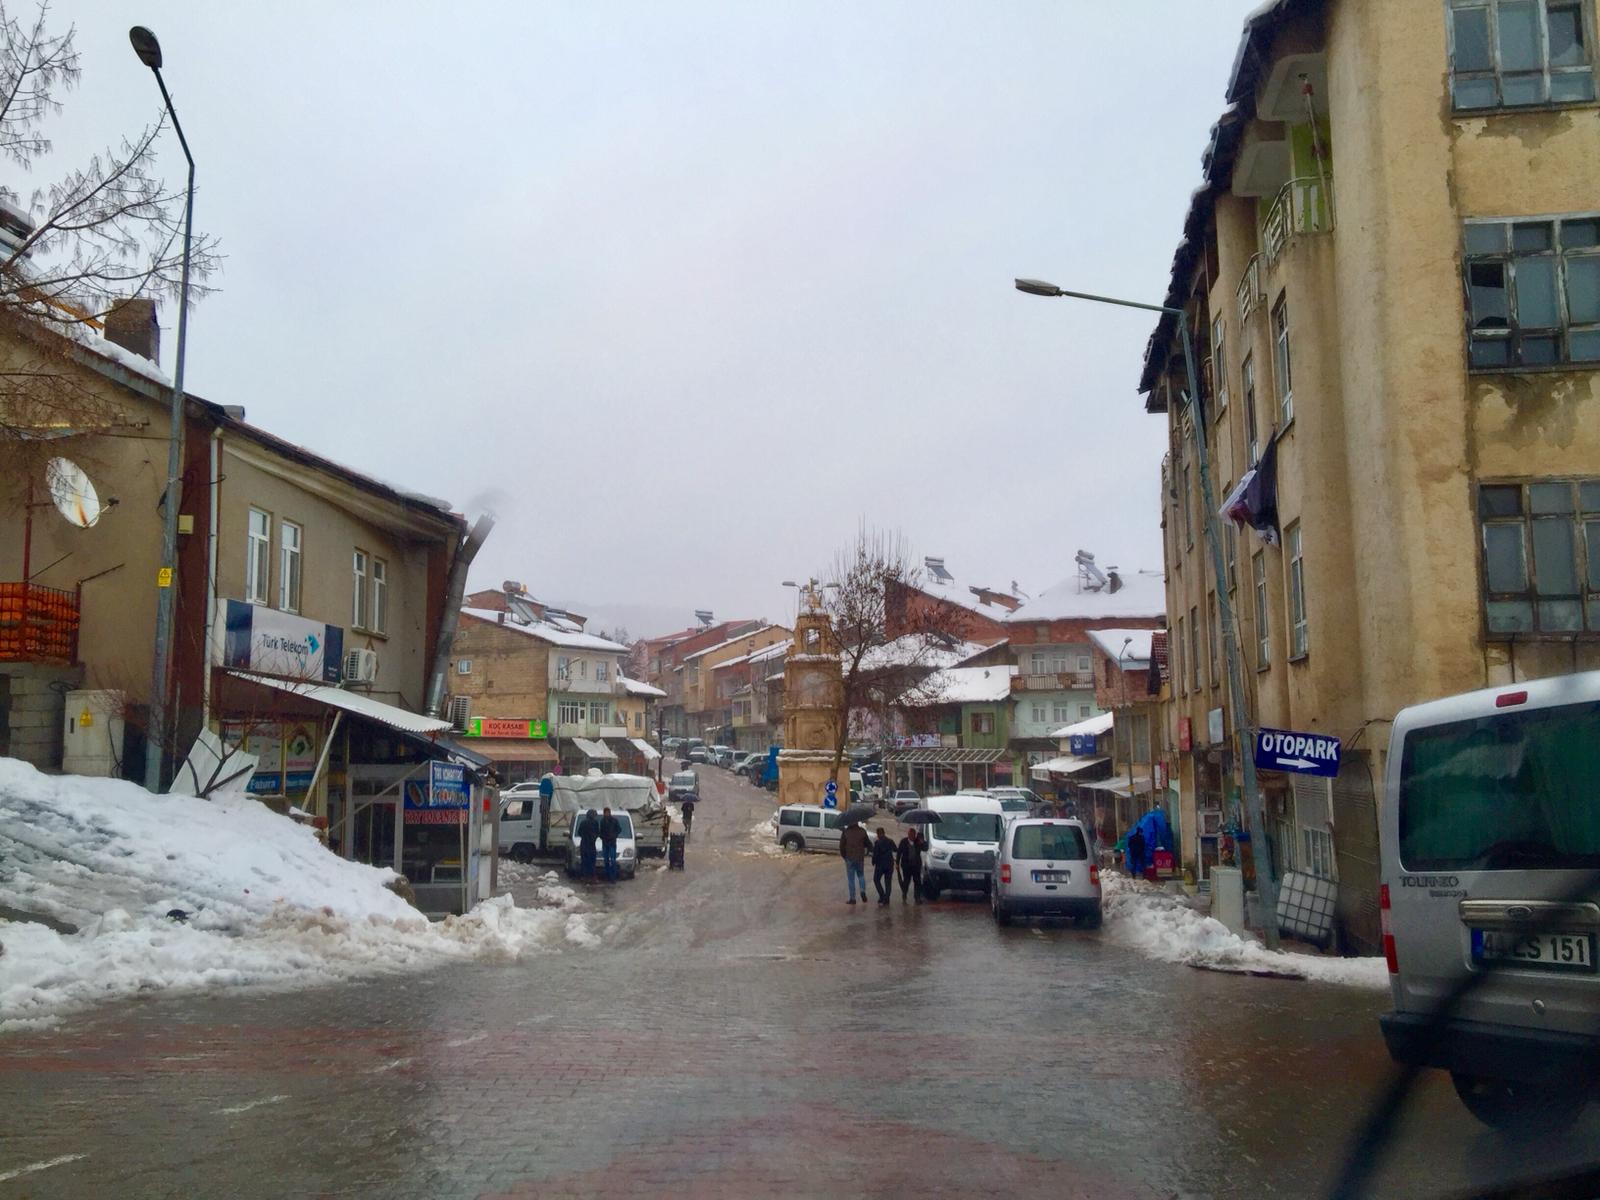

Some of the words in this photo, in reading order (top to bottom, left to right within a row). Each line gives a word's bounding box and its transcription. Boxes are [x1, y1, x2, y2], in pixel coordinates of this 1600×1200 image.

[262, 634, 279, 650] Türk
[280, 637, 309, 655] Telekom
[1262, 733, 1339, 761] OTOPARK
[1551, 937, 1584, 963] 151
